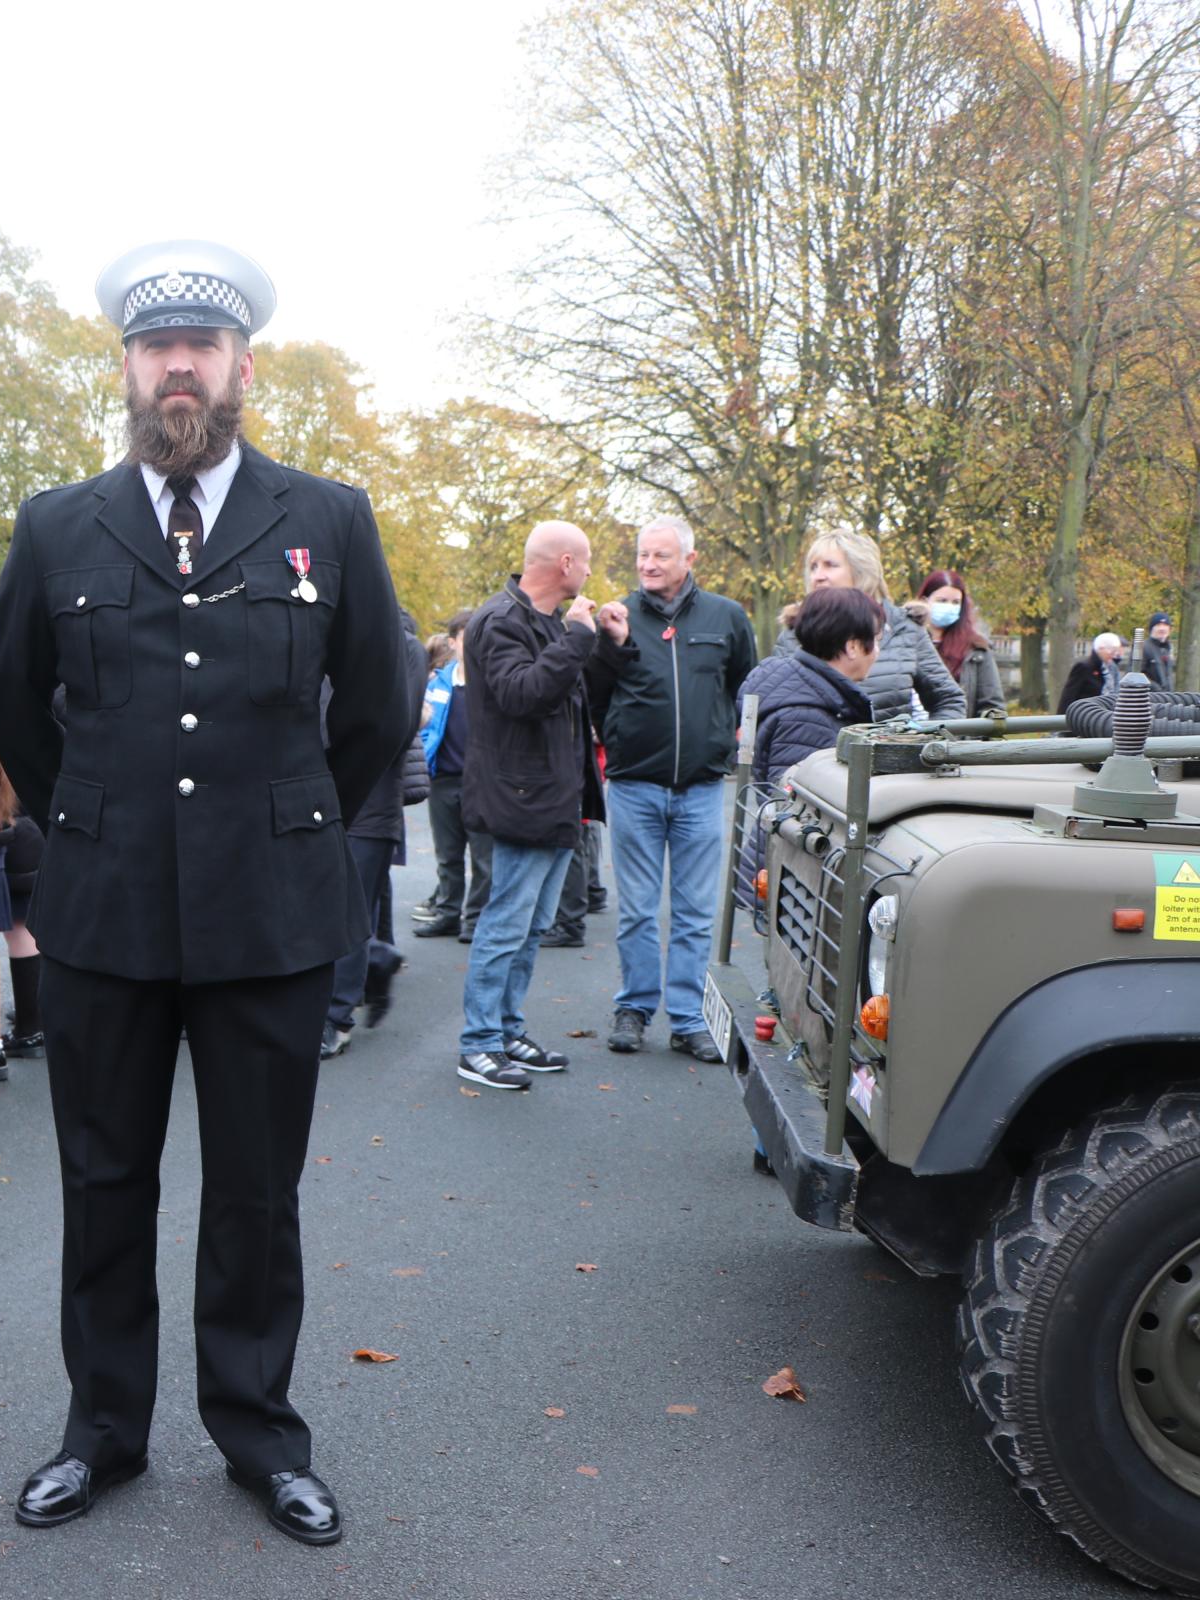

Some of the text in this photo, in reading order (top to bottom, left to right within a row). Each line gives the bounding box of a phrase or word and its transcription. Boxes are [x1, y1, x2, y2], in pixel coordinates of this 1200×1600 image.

[1174, 895, 1186, 903] Do
[1162, 904, 1185, 912] loiter
[1181, 915, 1190, 923] of
